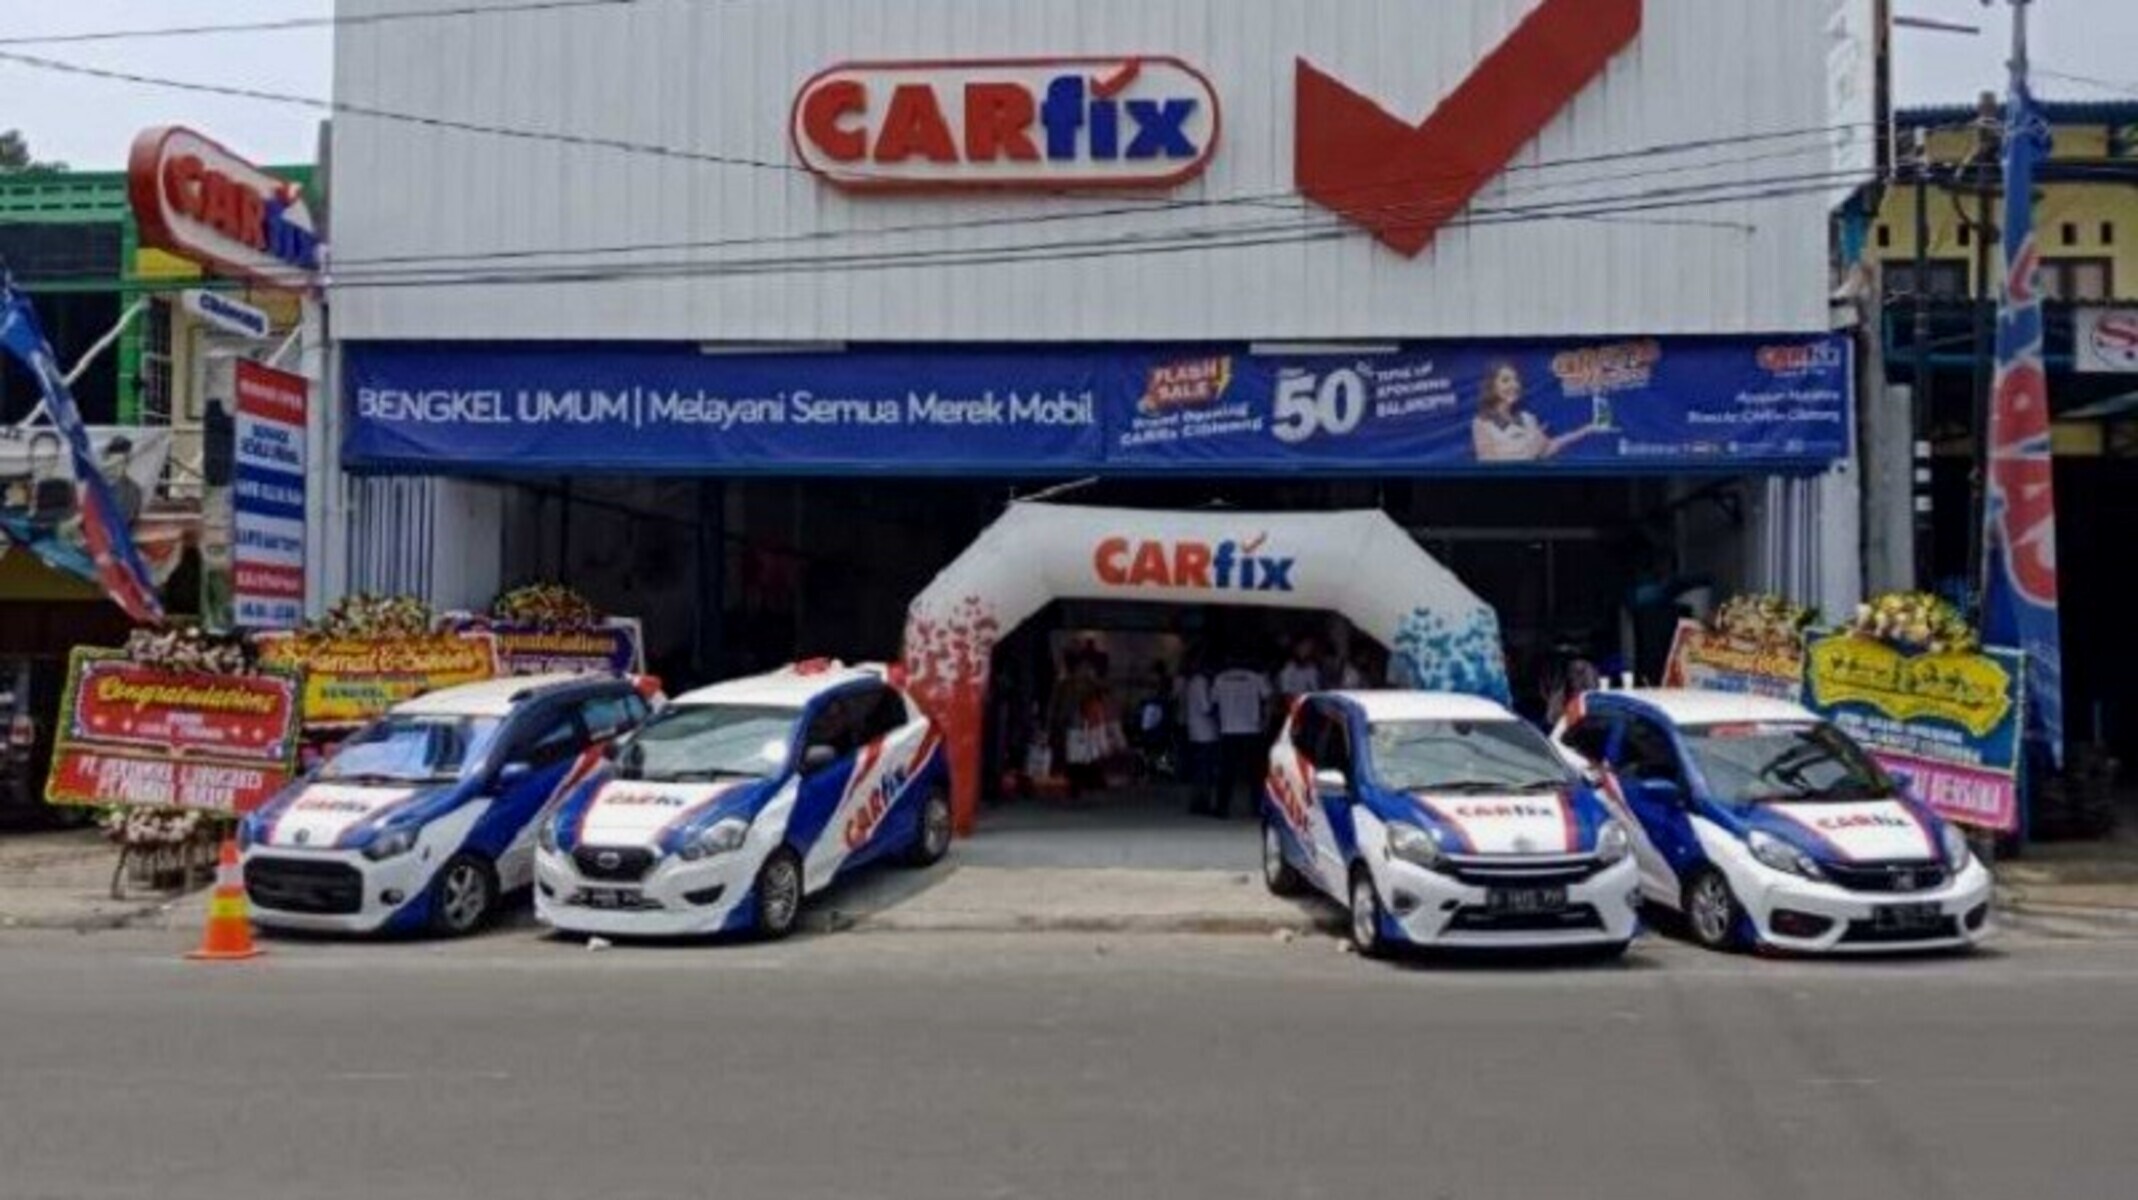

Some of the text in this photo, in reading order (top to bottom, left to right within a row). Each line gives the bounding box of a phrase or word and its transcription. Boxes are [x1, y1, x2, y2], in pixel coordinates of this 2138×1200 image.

[803, 56, 1199, 164] CARfix
[357, 387, 628, 424] BENGKEL UMUM
[650, 389, 1095, 431] Melayani Semua Merek Mobil
[1095, 532, 1295, 592] CARfix
[99, 675, 278, 713] Congratulations
